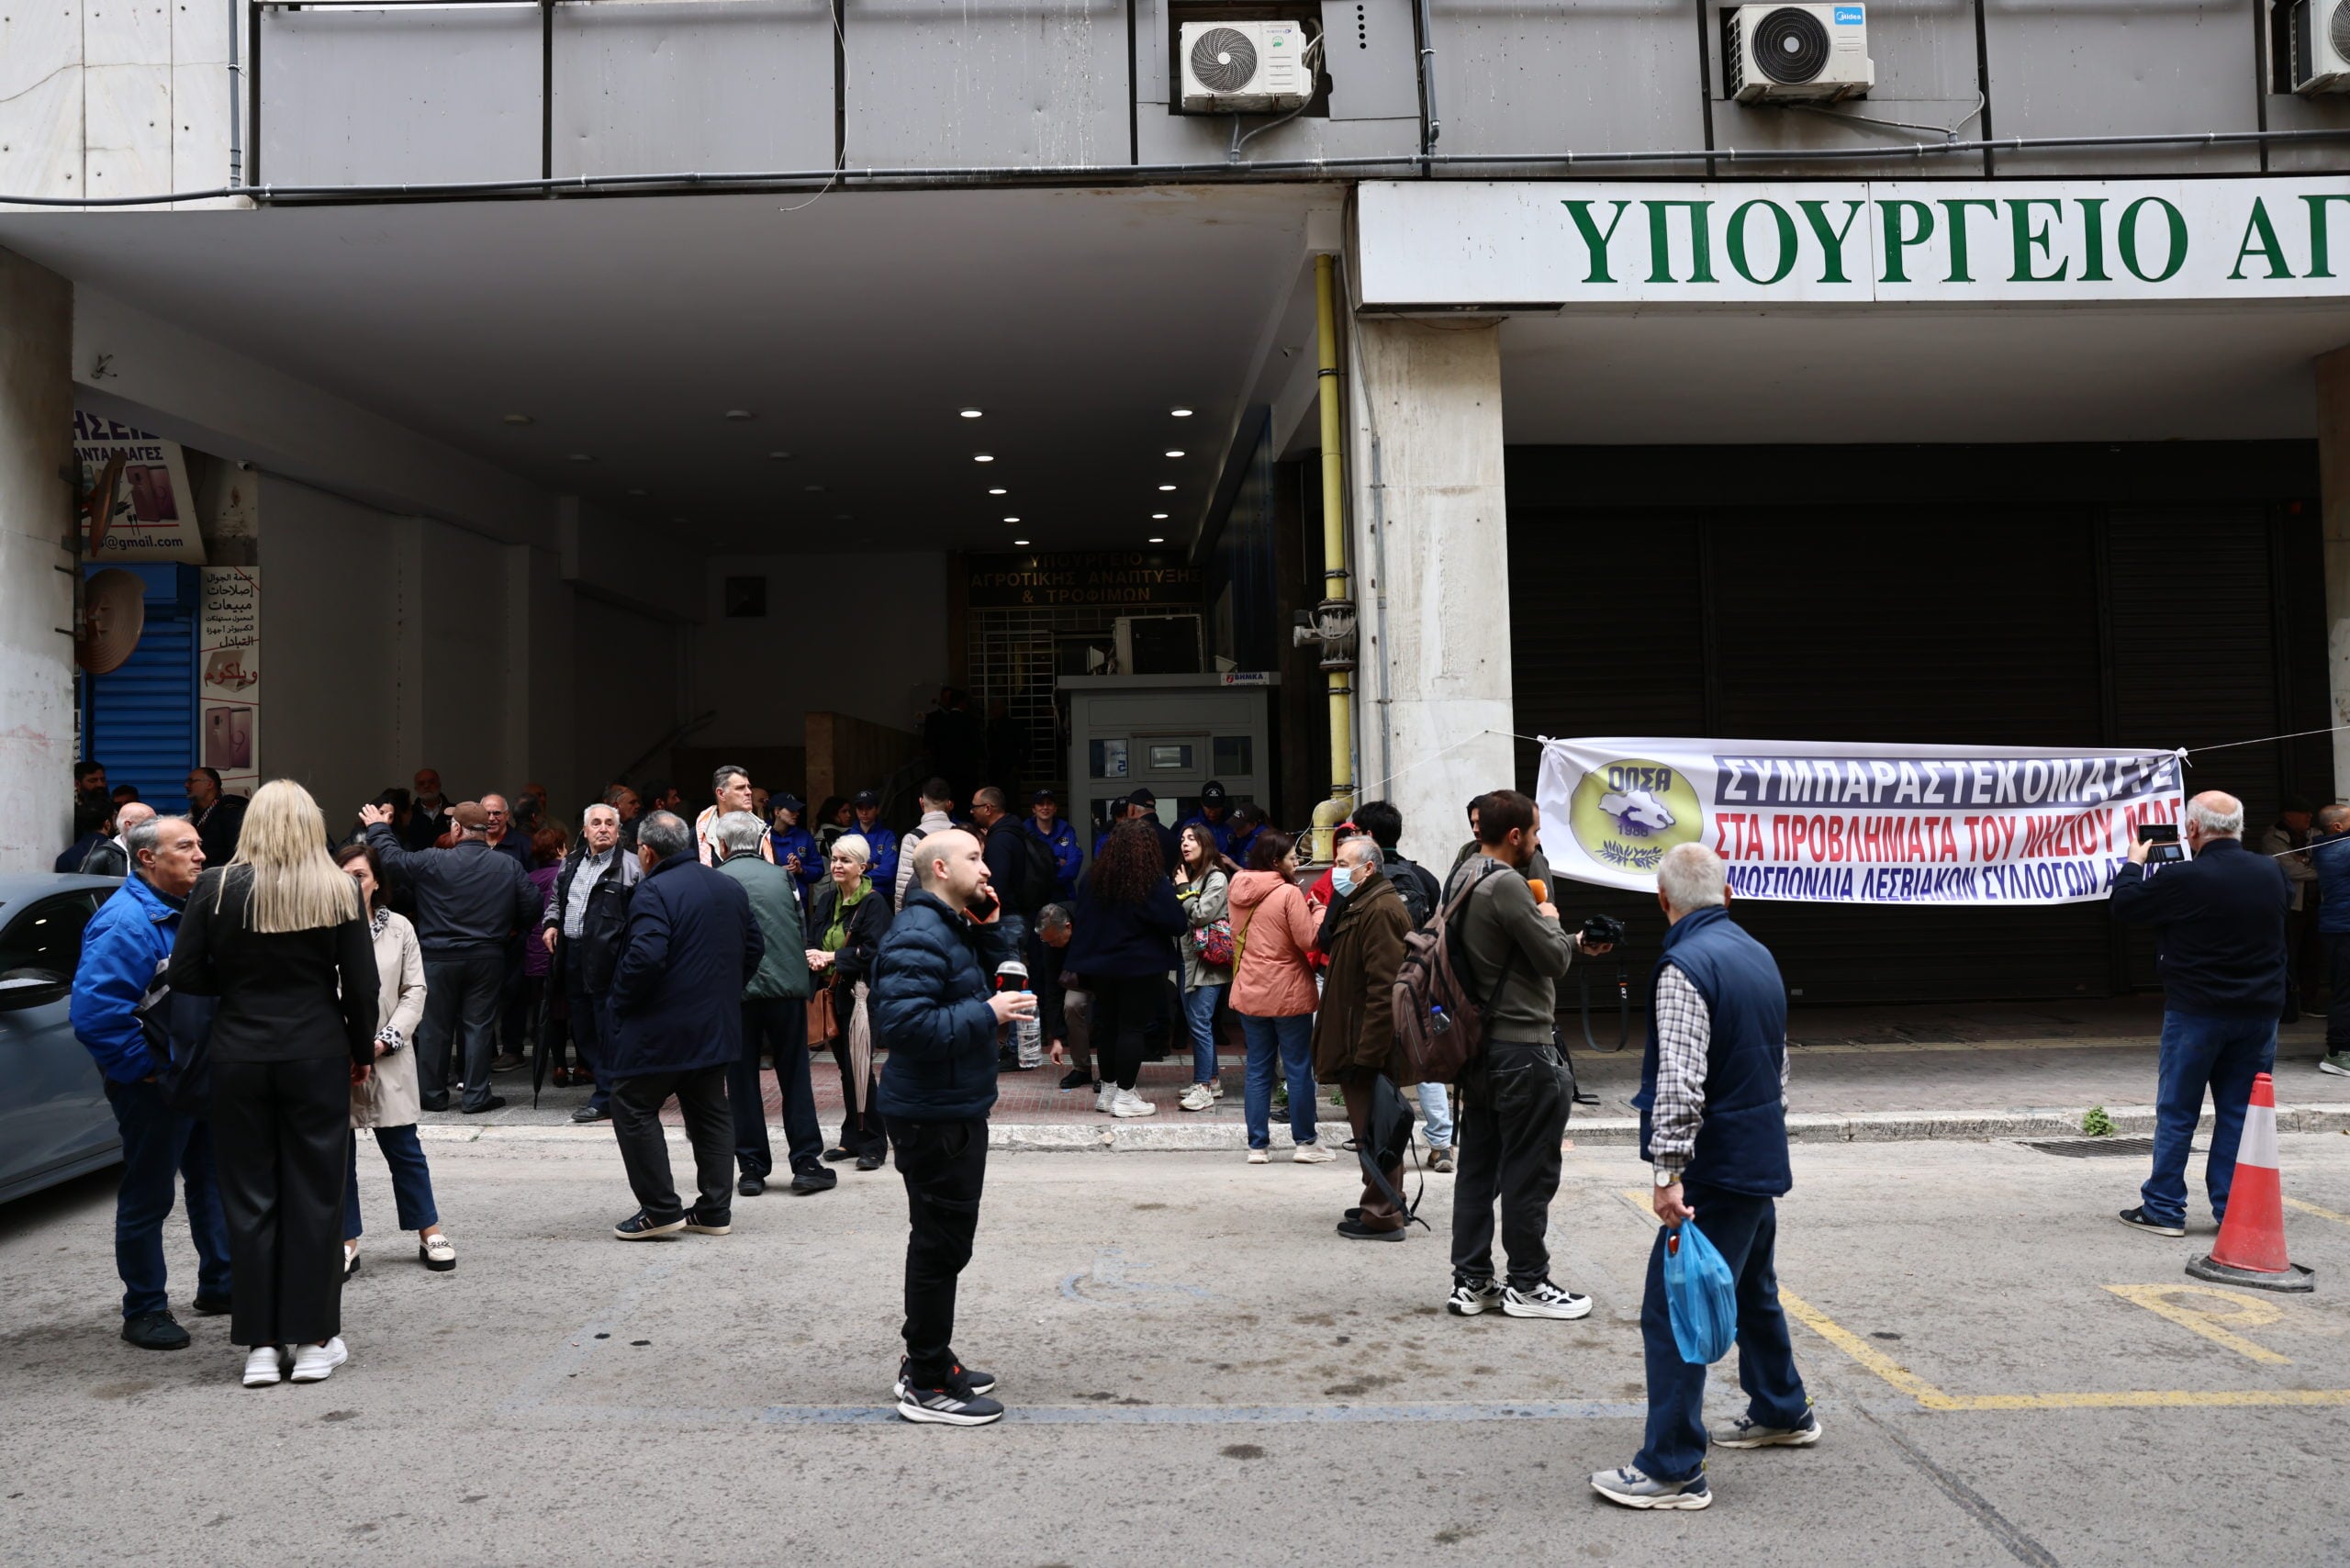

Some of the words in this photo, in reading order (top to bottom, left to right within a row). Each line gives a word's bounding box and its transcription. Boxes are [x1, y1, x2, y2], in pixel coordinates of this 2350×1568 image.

[1561, 196, 2189, 286] ΥΠΟΥΡΓΕΙΟ
[2226, 194, 2350, 280] ΑΓ
[100, 535, 184, 550] @gmail.com
[1029, 551, 1144, 568] ΥΠΟΥΡΓΕΙΟ
[207, 573, 231, 584] الجوال
[970, 571, 1077, 588] ΑΓΡΟΤΙΚΗΣ
[1088, 568, 1202, 585] ΑΝΑΠΤΥΞΗΣ
[207, 585, 253, 598] إصلاحات
[1022, 588, 1035, 603] &
[1046, 587, 1151, 603] ΤΡΟΦΙΜΩΝ
[207, 598, 252, 613] مبيعات
[219, 635, 254, 648] التبادل
[1715, 812, 1764, 861] ΣΤΑ
[1773, 814, 1957, 863] ΠΡΟΒΛΗΜΑΤΑ
[1964, 815, 2016, 863] ΤΟΥ
[1727, 865, 1854, 900] ΜΟΣΠΟΝΔΙΑ
[1861, 867, 1979, 901] ΛΕΣΒΙΑΚΩΝ
[1982, 860, 2098, 900] ΣΥΛΛΟΓΩΝ
